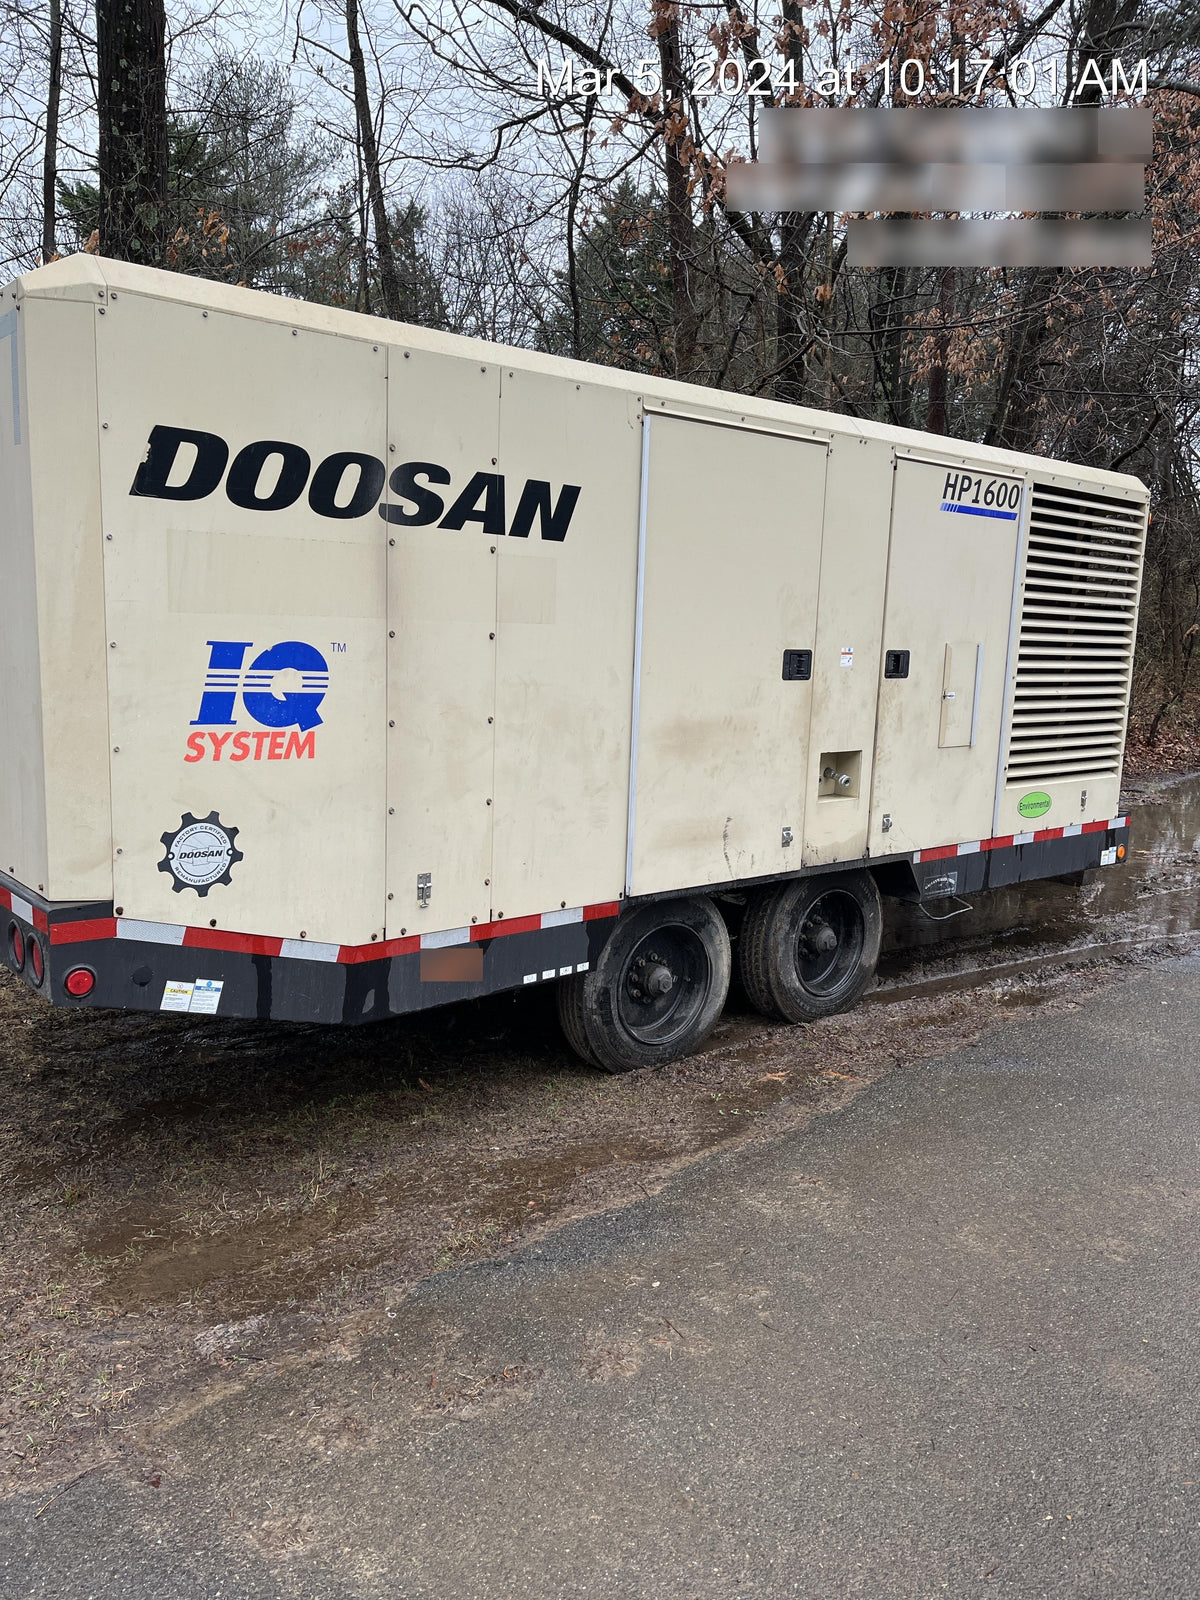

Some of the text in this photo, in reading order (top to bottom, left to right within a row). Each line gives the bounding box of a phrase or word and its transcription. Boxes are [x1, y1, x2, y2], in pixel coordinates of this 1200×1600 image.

[129, 425, 581, 542] DOOSAN
[942, 472, 1021, 509] HP1600
[190, 640, 329, 733] IQ
[183, 731, 315, 763] SYSTEM
[174, 825, 228, 848] FACTORY CERTIFIED
[178, 850, 224, 860] DOOSAN
[174, 862, 227, 884] REMANUFACTURED
